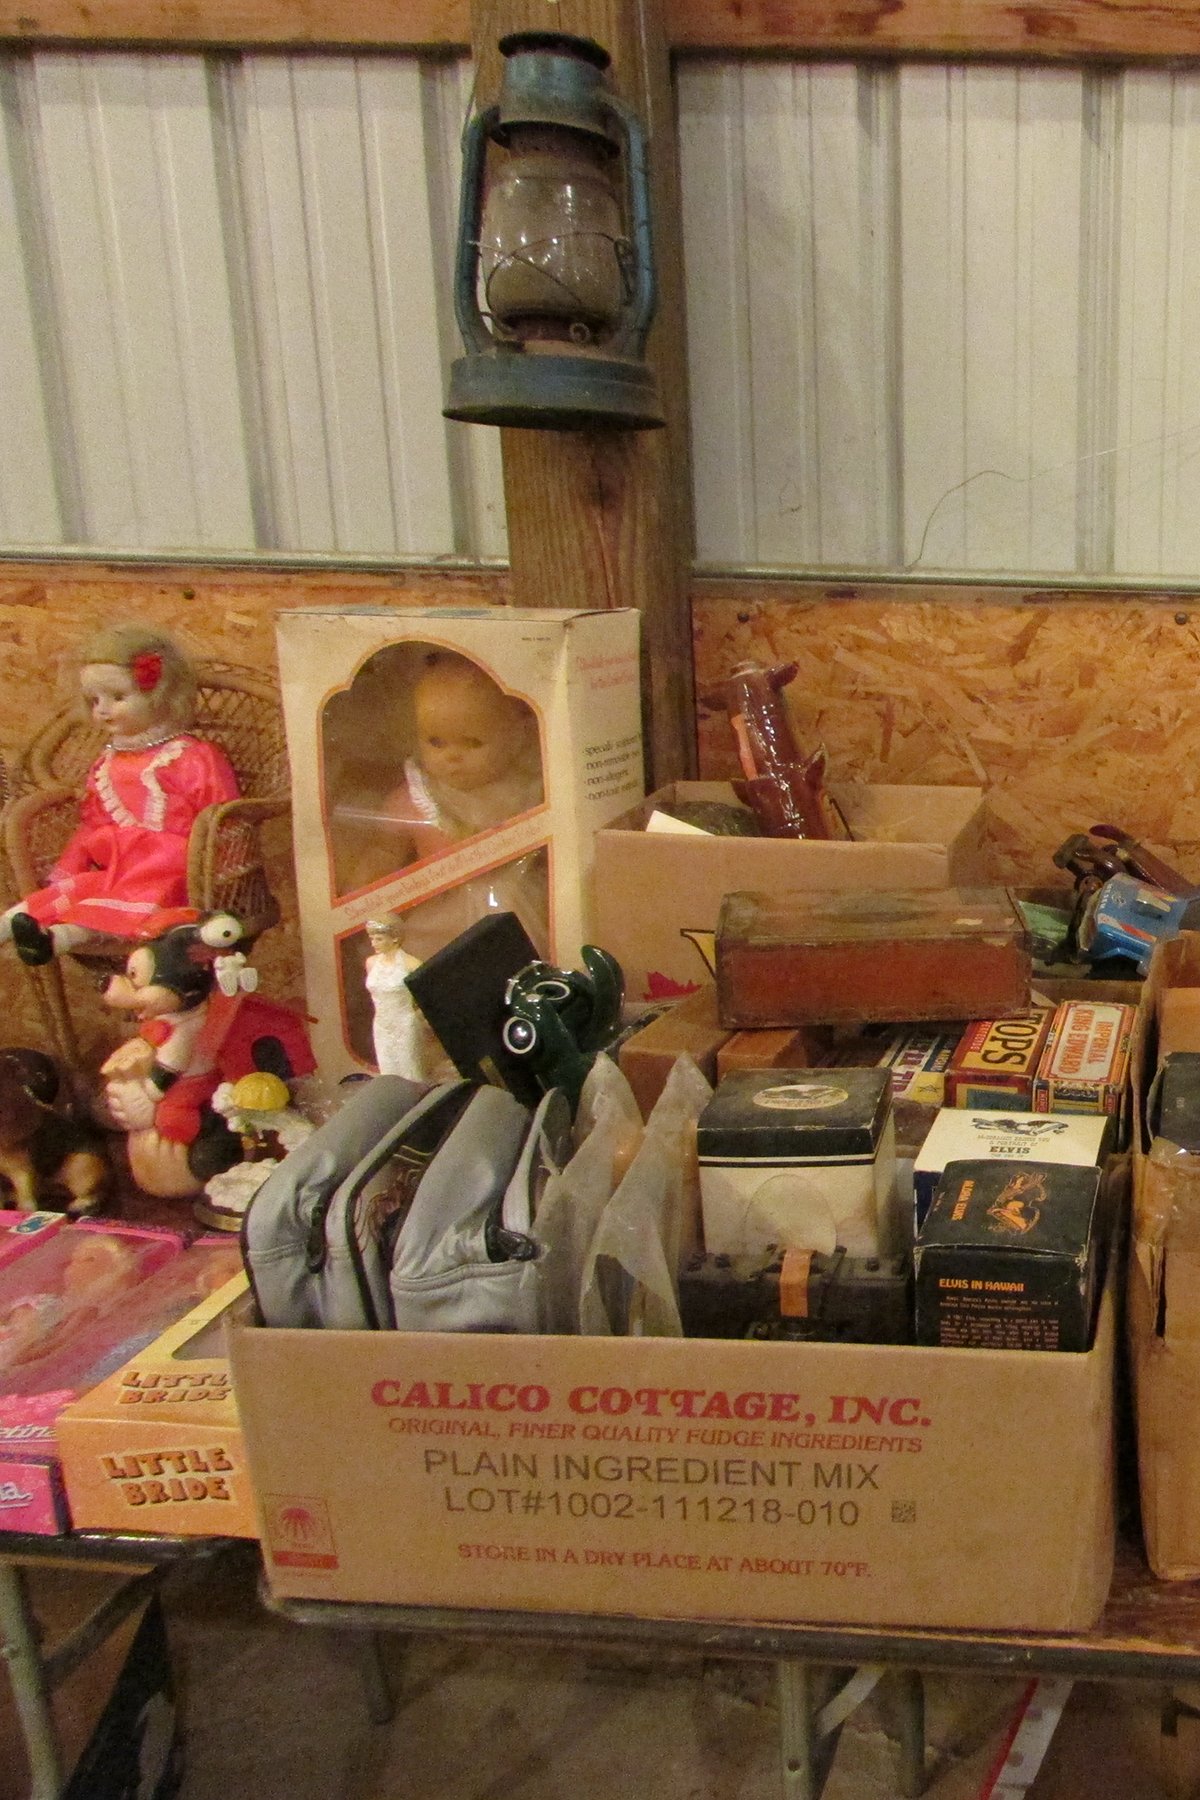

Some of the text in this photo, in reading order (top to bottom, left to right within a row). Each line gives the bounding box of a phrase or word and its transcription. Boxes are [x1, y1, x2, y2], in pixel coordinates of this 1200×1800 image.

[1071, 1009, 1095, 1031] KING
[981, 1013, 1045, 1065] TOPS
[1058, 1033, 1089, 1074] EDWARD
[989, 1146, 1031, 1154] ELVIS
[939, 1278, 1025, 1292] ELVIS IN HAWAII
[122, 1371, 228, 1389] LITTL
[119, 1389, 231, 1405] BRIDE
[370, 1378, 933, 1428] CALICO COTTAGE, INC.
[388, 1417, 923, 1453] ORIGINAL, FINER QUALITY FUDGE INGREDIENTS
[101, 1447, 234, 1479] LITTLE
[424, 1449, 880, 1490] PLAIN INGREDIENT MIX
[120, 1476, 231, 1506] BRIDE
[444, 1486, 859, 1527] LOT#1002-111218-010
[458, 1543, 531, 1562] STORE
[535, 1547, 557, 1564] IN
[563, 1548, 579, 1565] A
[585, 1550, 627, 1567] DRY
[632, 1551, 701, 1570] PLACE
[706, 1555, 733, 1572] AT
[739, 1557, 815, 1576] ABOUT
